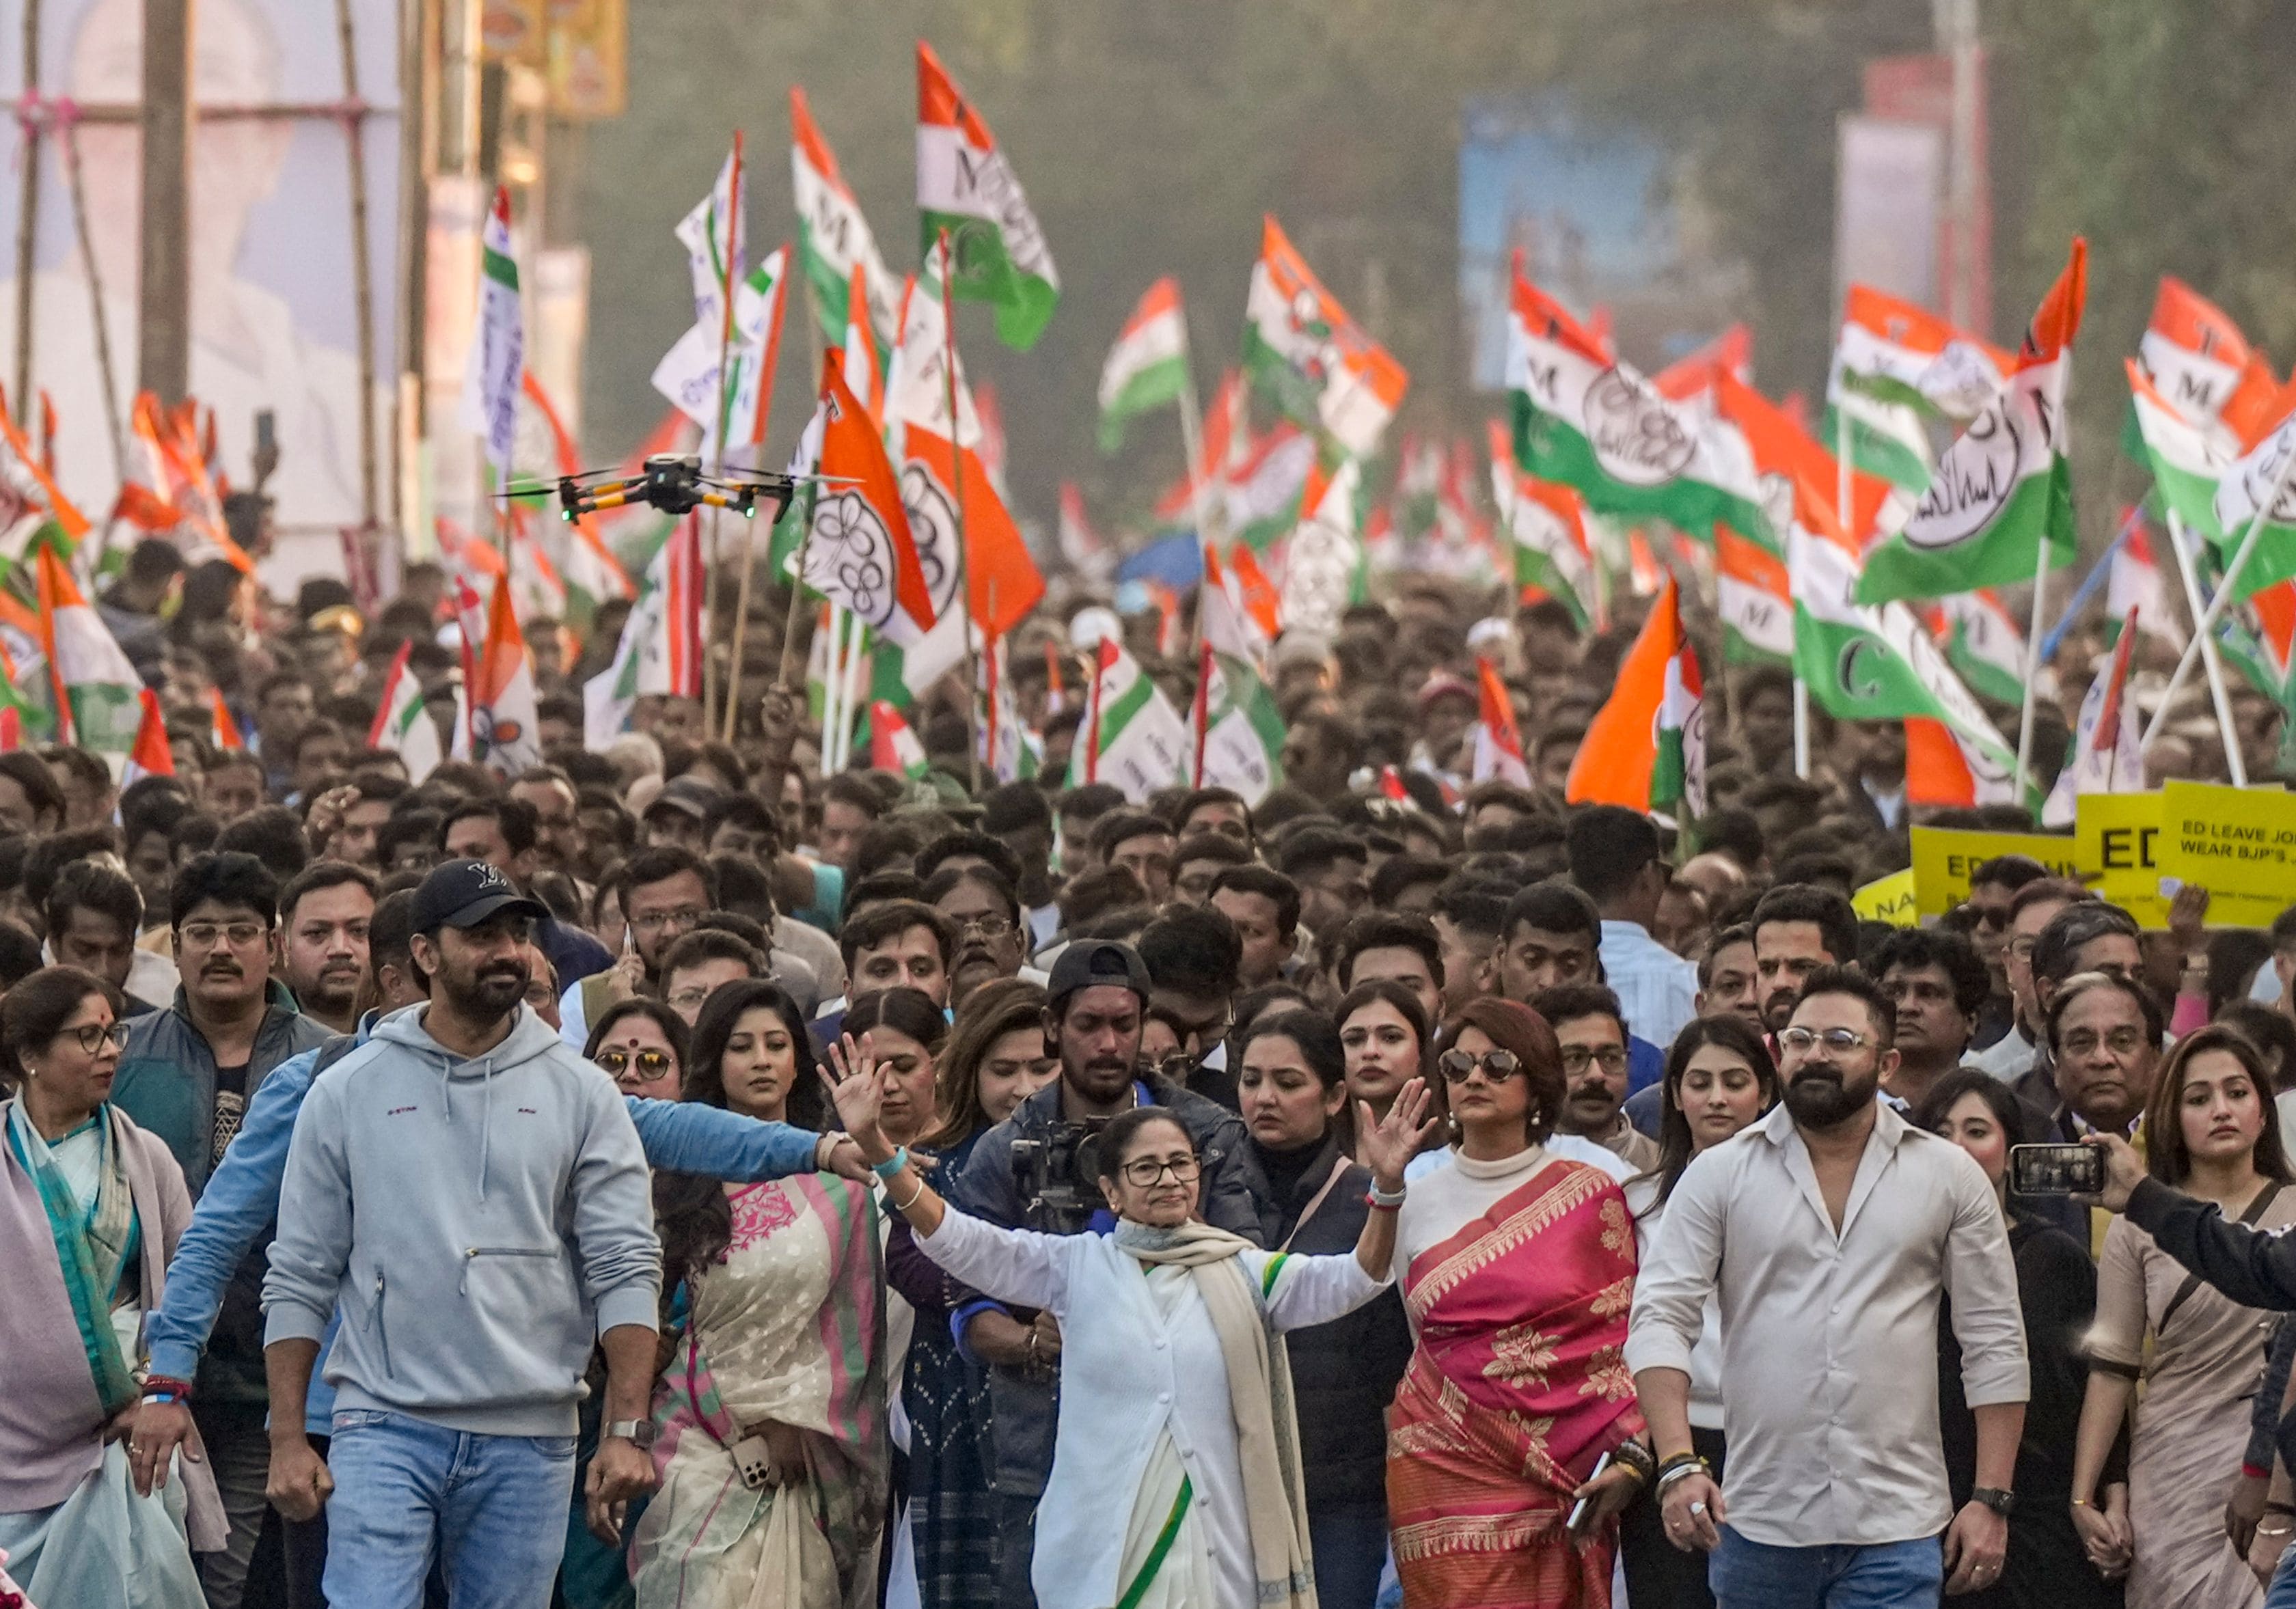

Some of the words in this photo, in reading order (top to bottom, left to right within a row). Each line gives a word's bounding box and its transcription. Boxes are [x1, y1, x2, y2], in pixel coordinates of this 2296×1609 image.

[2183, 820, 2205, 835] ED
[2211, 823, 2266, 841] LEAVE
[2270, 830, 2296, 844] JO
[2181, 840, 2232, 858] WEAR
[2237, 845, 2286, 863] BJP'S
